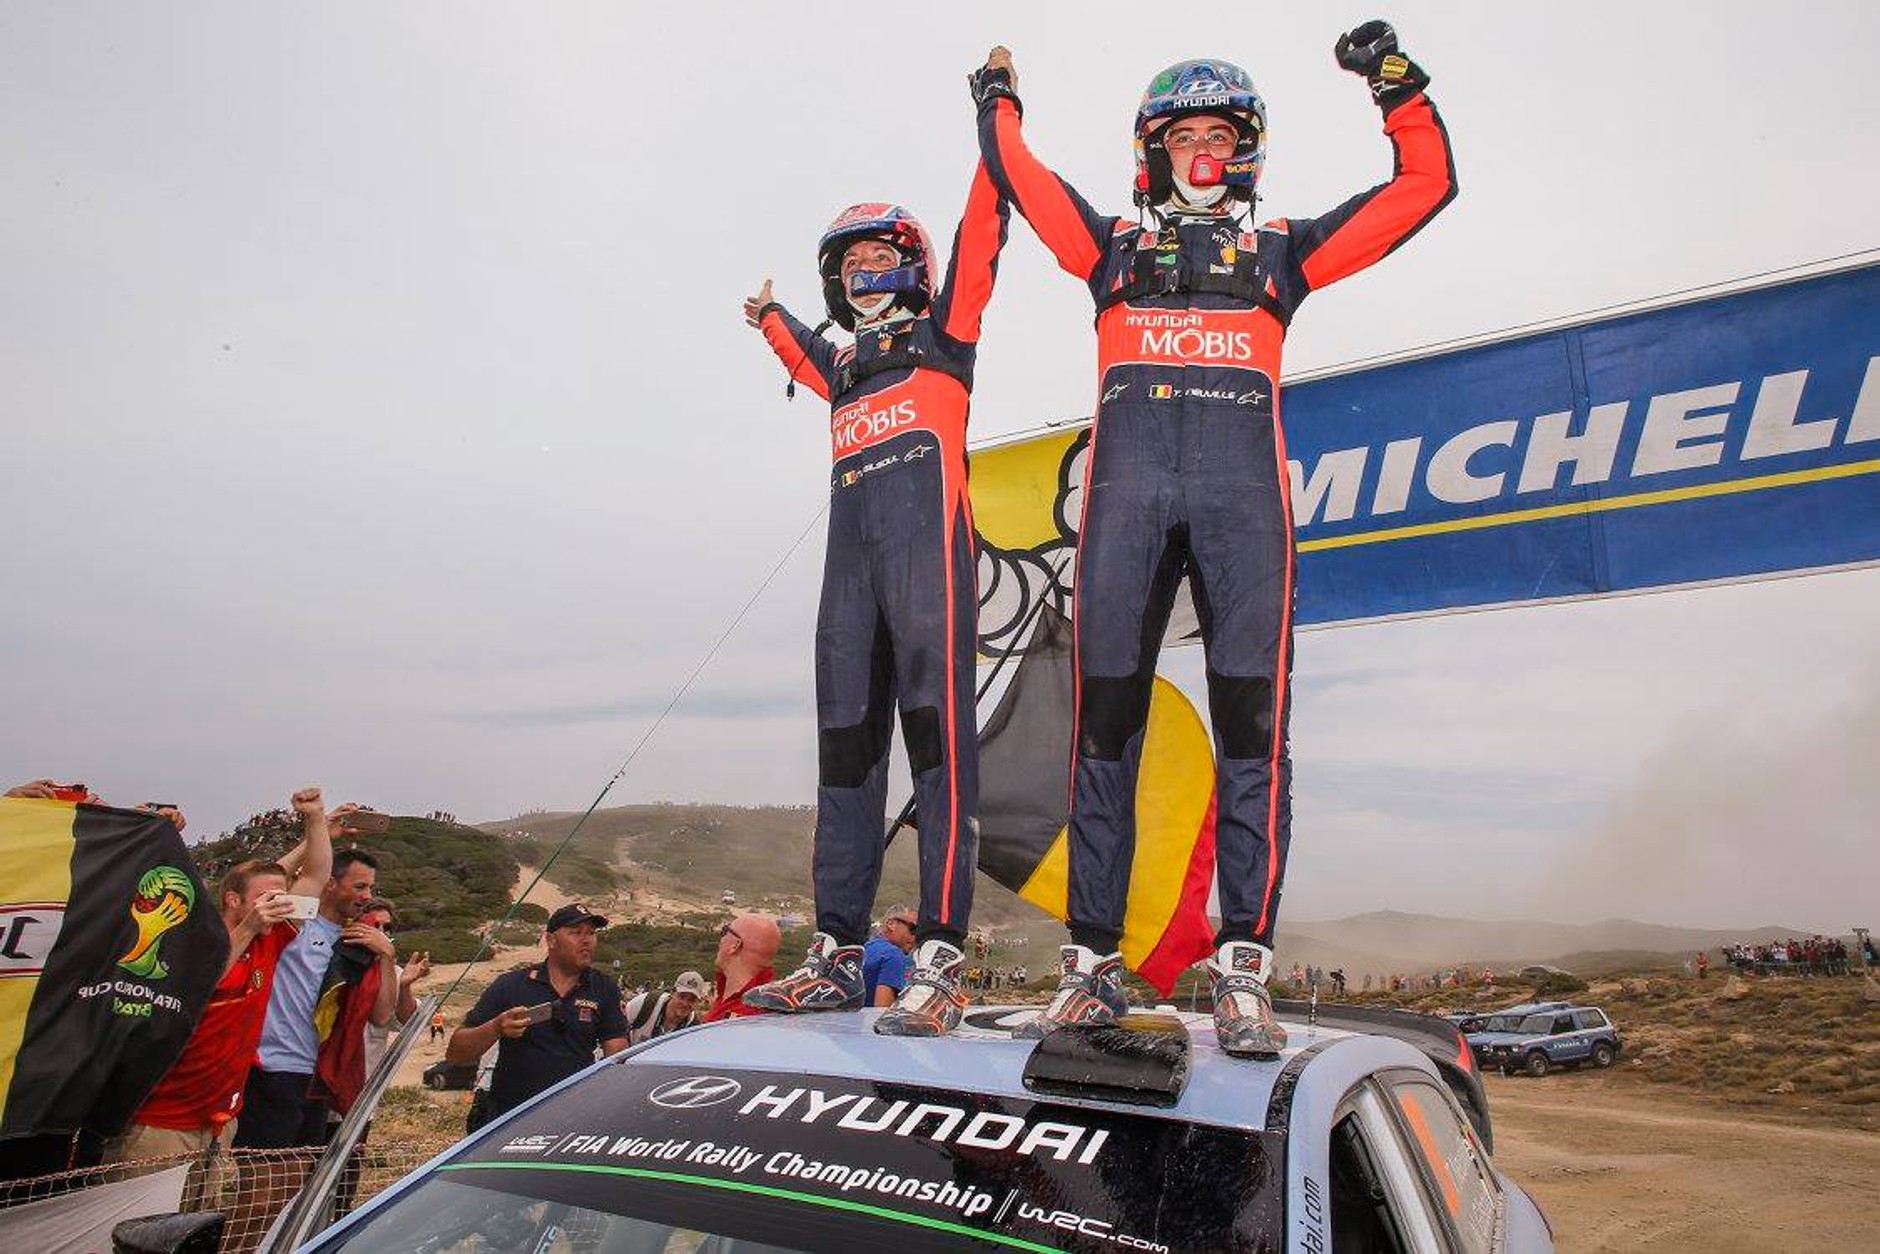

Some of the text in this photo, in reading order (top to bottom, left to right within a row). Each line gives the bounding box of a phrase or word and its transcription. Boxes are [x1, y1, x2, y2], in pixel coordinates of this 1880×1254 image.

[1173, 95, 1230, 109] HYUNDAI
[1126, 314, 1203, 327] HYUNDAI
[1141, 328, 1251, 361] MOBIS
[834, 399, 916, 454] MOBIS
[738, 1084, 1110, 1164] HYUNDAI
[560, 1134, 993, 1218] FIA World Rally Championship
